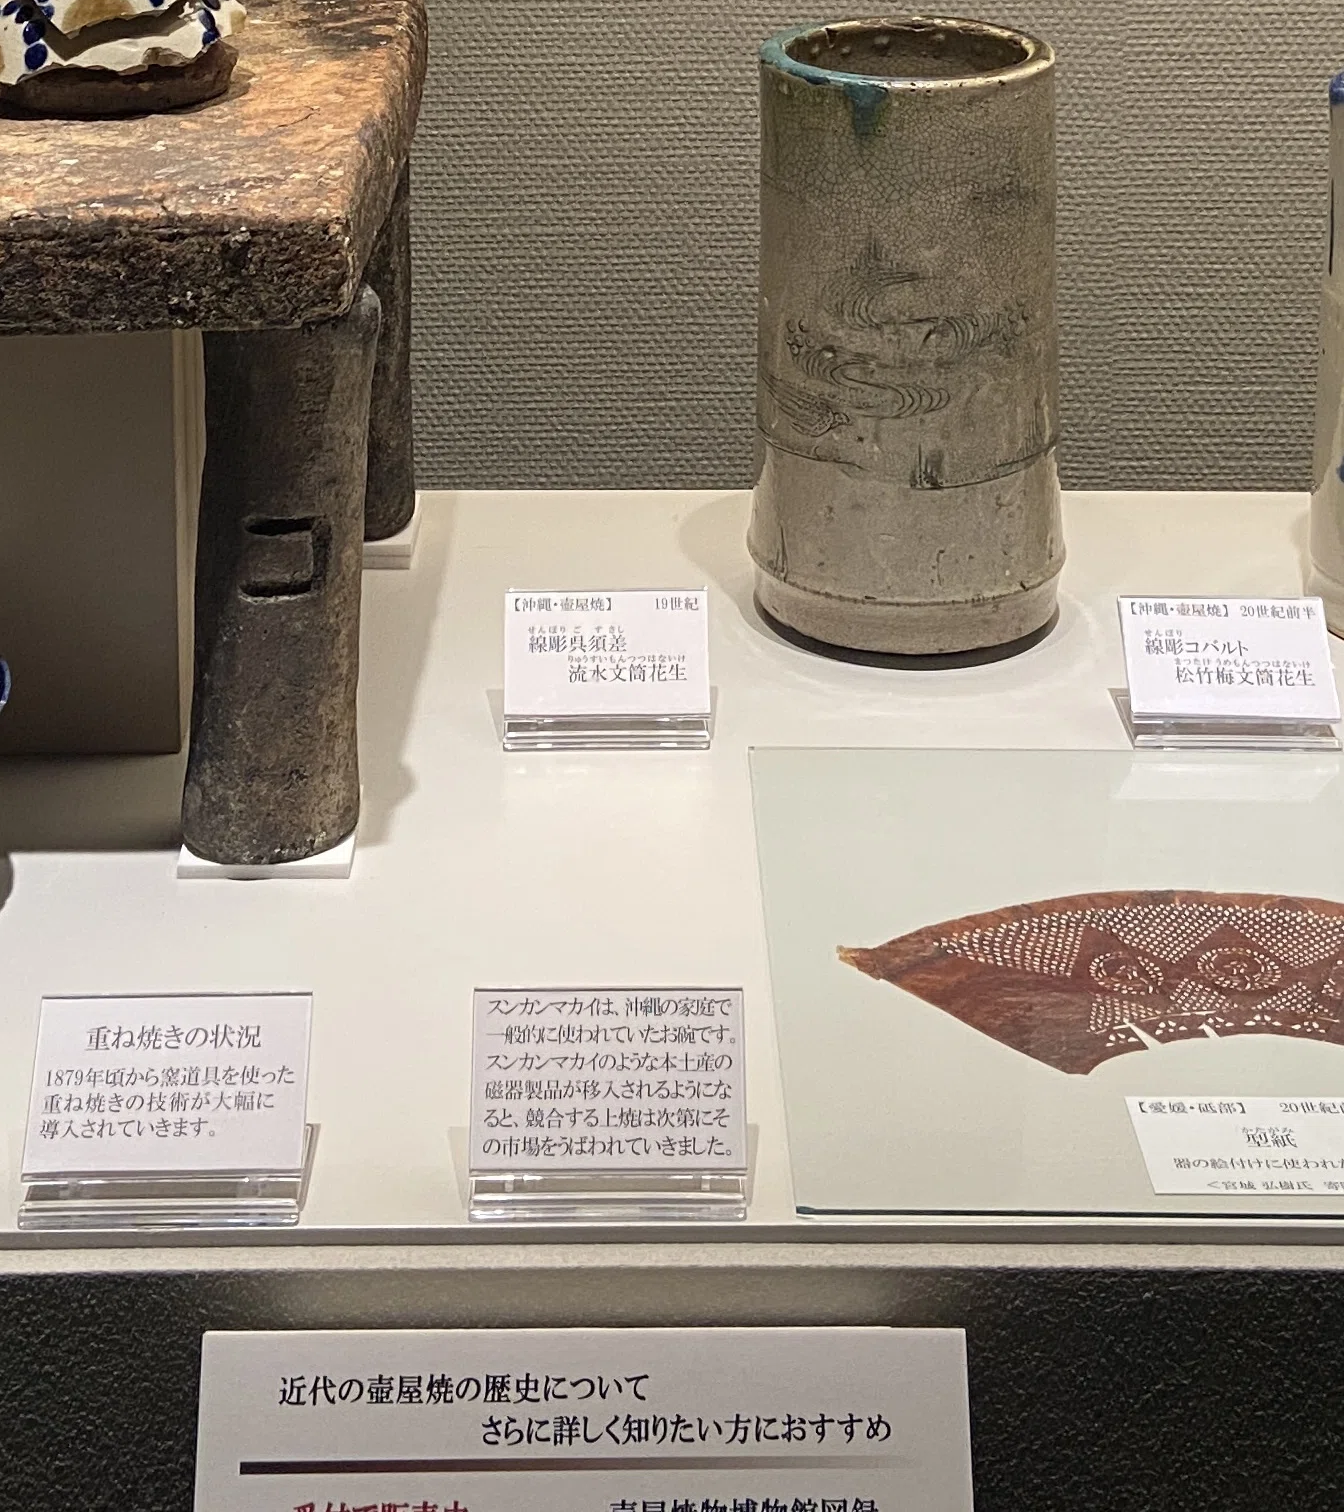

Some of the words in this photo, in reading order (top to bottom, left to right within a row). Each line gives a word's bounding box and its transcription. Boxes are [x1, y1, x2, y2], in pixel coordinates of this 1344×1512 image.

[654, 596, 700, 612] 19世紀
[1240, 605, 1317, 621] 20世紀前半
[84, 1024, 262, 1051] 重ね焼きの状況
[485, 1051, 733, 1073] スンカンマカイのような本土産の
[484, 1079, 732, 1101] 磁器製品が移入されるようにな
[42, 1090, 275, 1114] 重ね焼きの技術が大幅に
[39, 1117, 217, 1141] 導入されていきます。
[482, 1135, 733, 1158] の市場をうばわれていきました。
[480, 1414, 892, 1446] さらに詳しく知りたい方におすすめ
